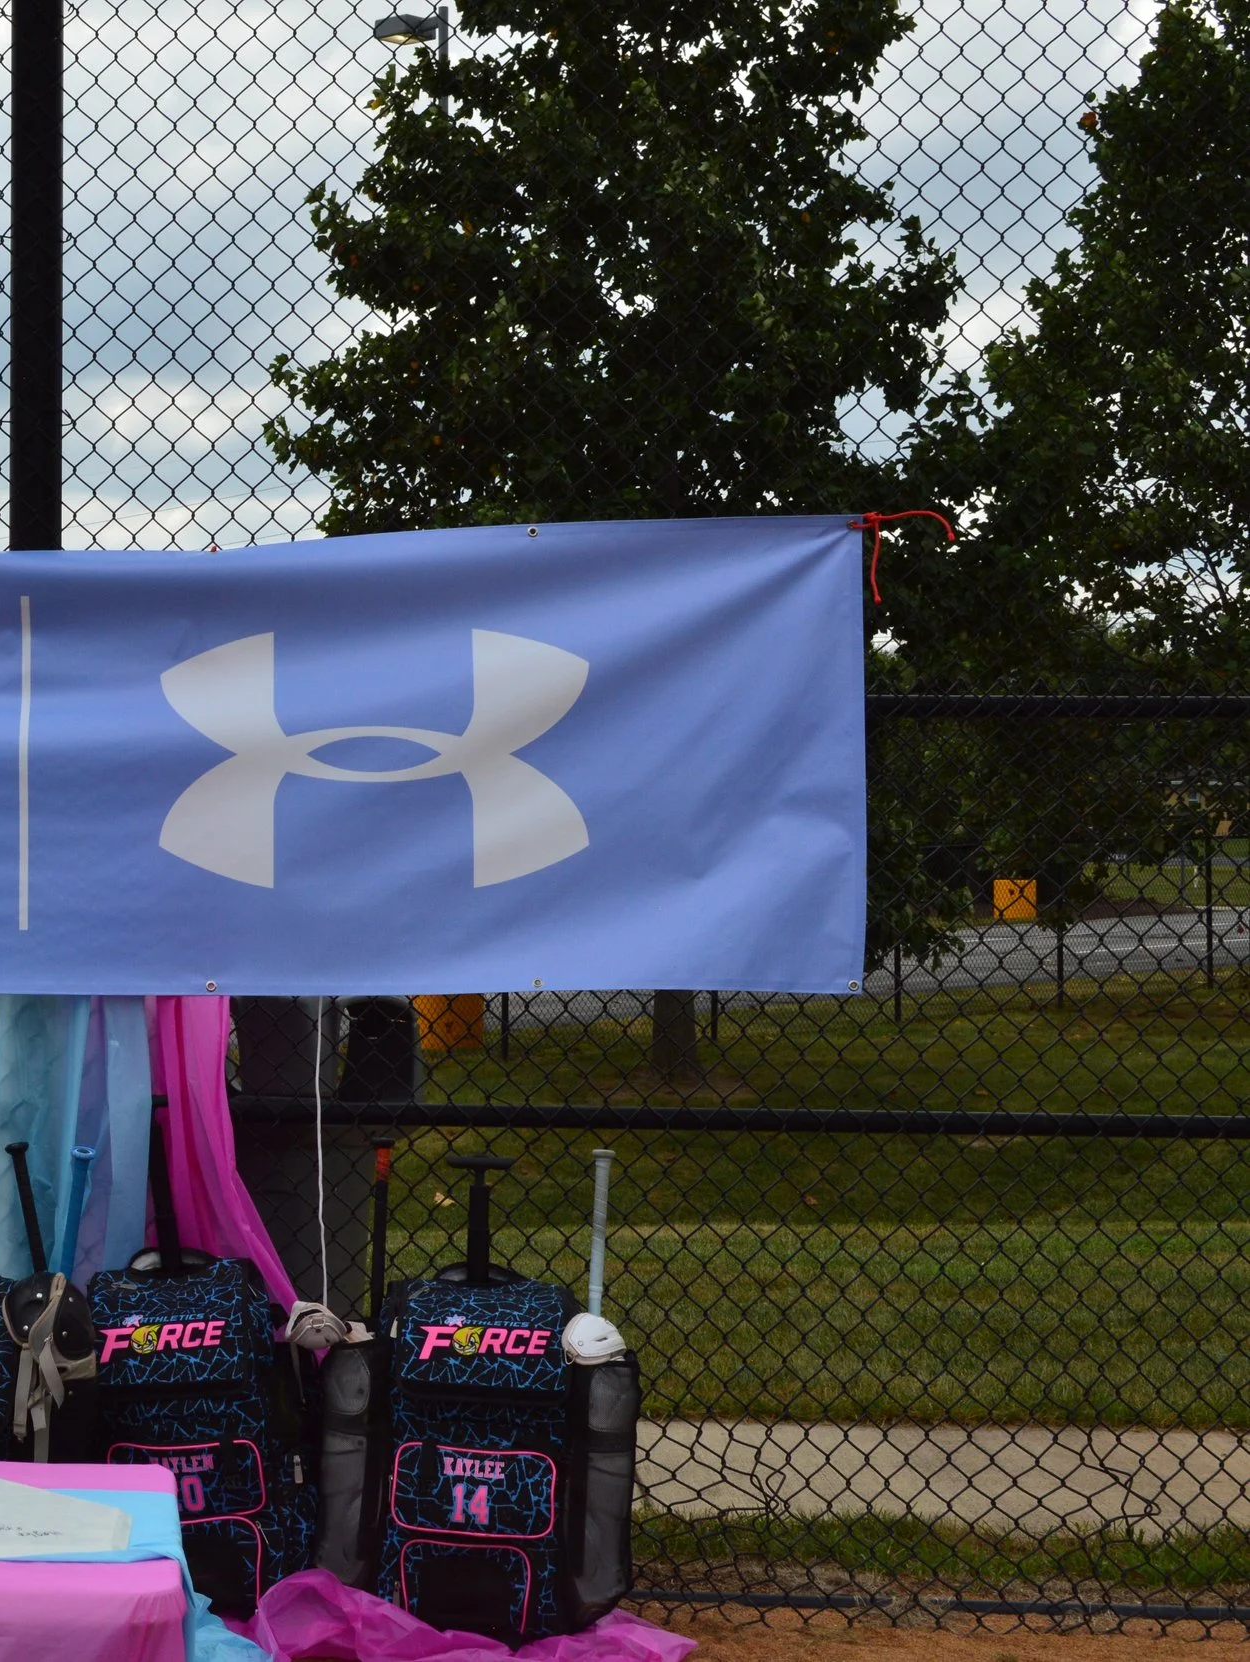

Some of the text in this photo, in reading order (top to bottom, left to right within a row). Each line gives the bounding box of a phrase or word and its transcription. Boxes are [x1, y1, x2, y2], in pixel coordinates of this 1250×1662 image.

[140, 1313, 204, 1325] ATHLETICS
[462, 1319, 530, 1328] ATHLETICS
[442, 1457, 506, 1480] KAYLEE
[179, 1474, 206, 1512] 0
[451, 1483, 490, 1525] 14
